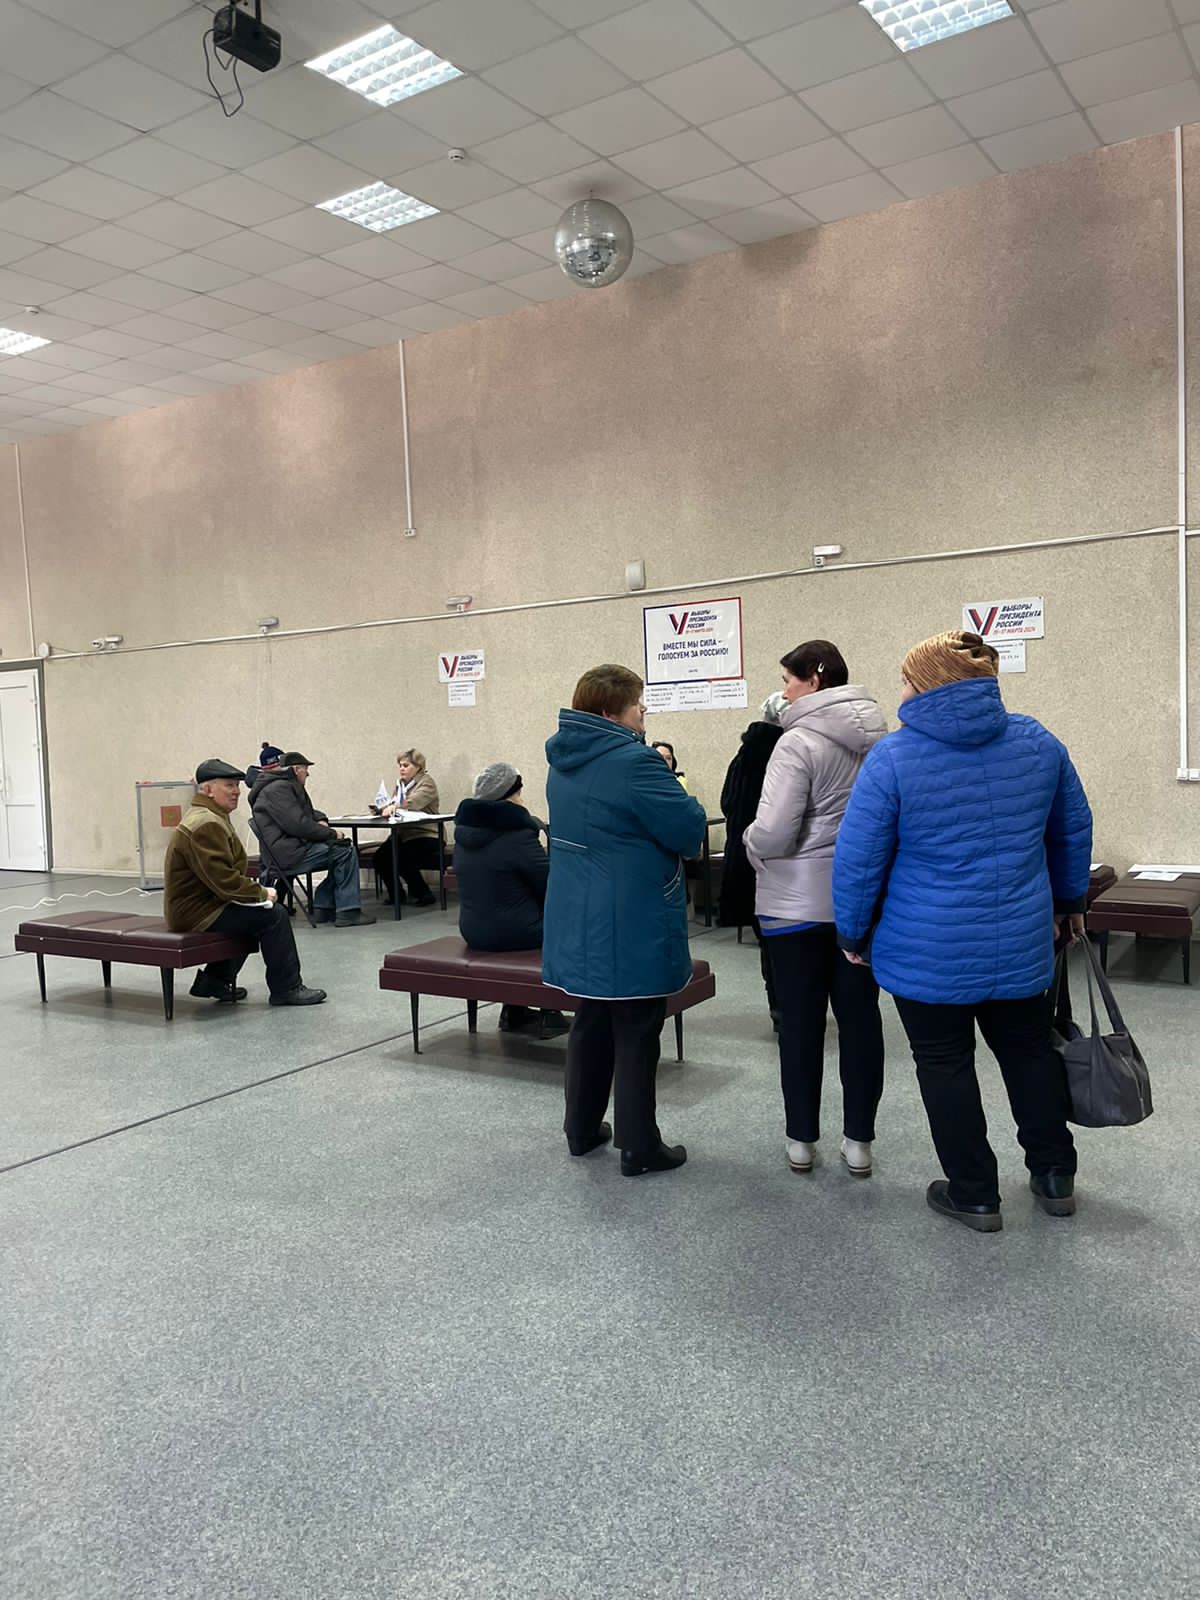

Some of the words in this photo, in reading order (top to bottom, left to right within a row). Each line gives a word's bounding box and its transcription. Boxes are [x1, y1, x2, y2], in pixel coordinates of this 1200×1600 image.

[1002, 604, 1032, 612] ВЫБОРЫ
[998, 610, 1042, 620] ПРЕЗИДЕНТА
[995, 620, 1023, 628] РОССИИ
[663, 641, 686, 651] ВМЕСТЕ
[687, 640, 699, 648] МЫ
[699, 639, 717, 647] СИЛА
[657, 651, 690, 661] ГОЛОСУЕМ
[690, 650, 699, 658] ЗА
[699, 647, 729, 657] РОССИЮ!
